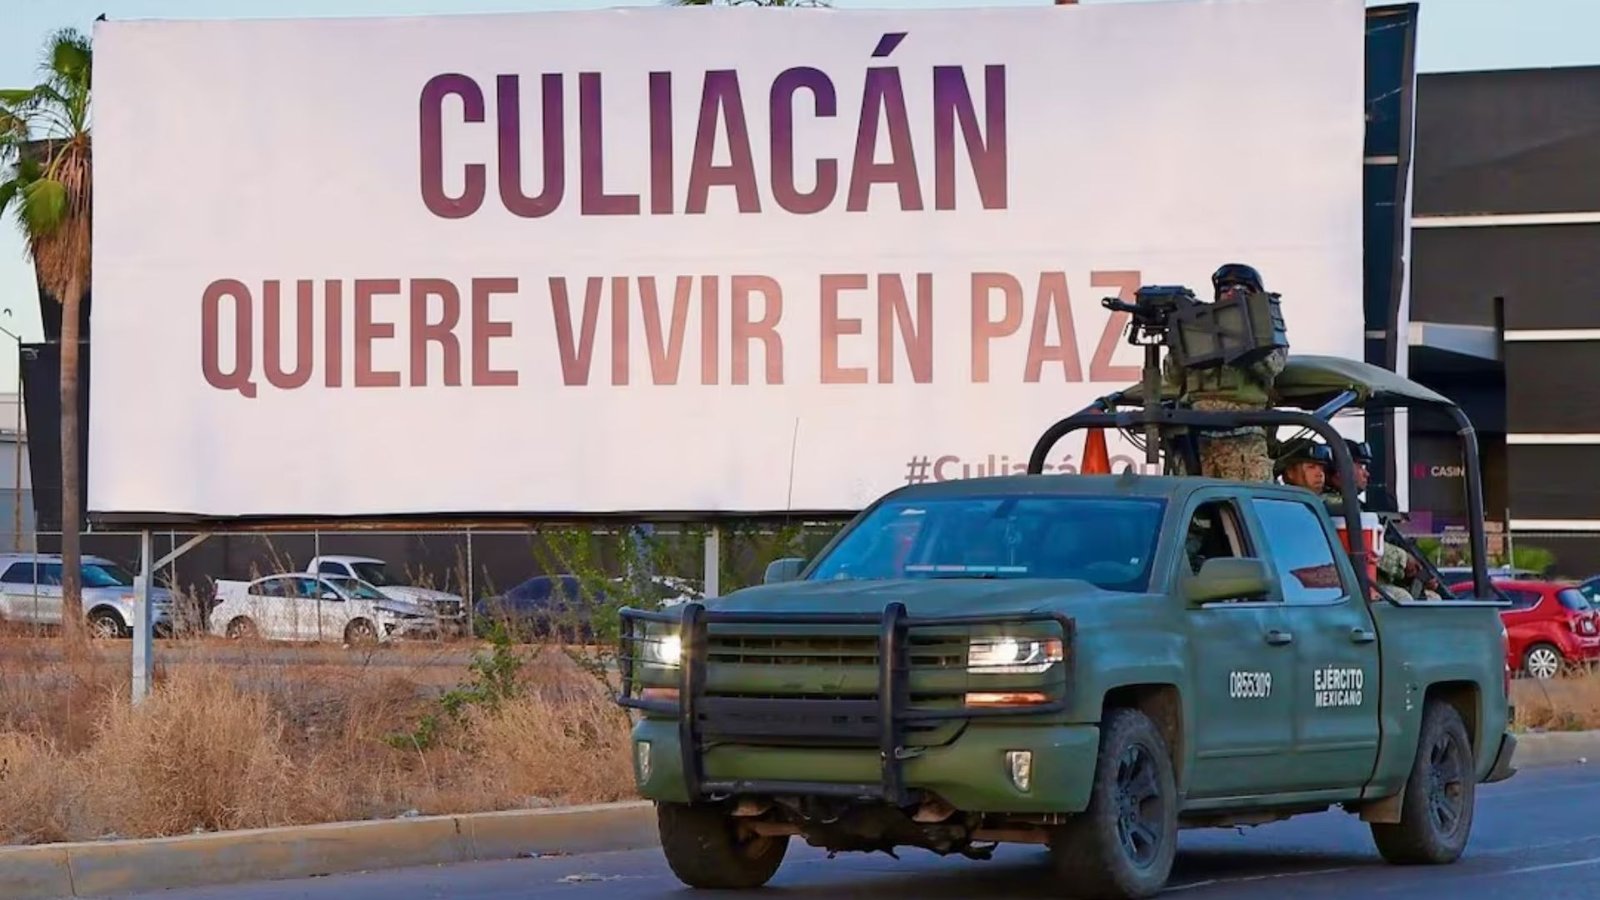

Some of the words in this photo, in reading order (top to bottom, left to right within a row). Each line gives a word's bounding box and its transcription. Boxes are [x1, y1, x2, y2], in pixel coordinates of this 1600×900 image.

[420, 32, 1007, 218] CULIACÁN
[202, 277, 518, 398] QUIERE
[549, 275, 783, 386] VIVIR
[820, 273, 932, 383] EN
[971, 271, 1141, 382] PAZ
[1431, 466, 1465, 477] CASIN
[1230, 671, 1271, 698] 0855309
[1314, 664, 1363, 691] EJÉRCITO
[1315, 691, 1363, 707] MEXICANO
